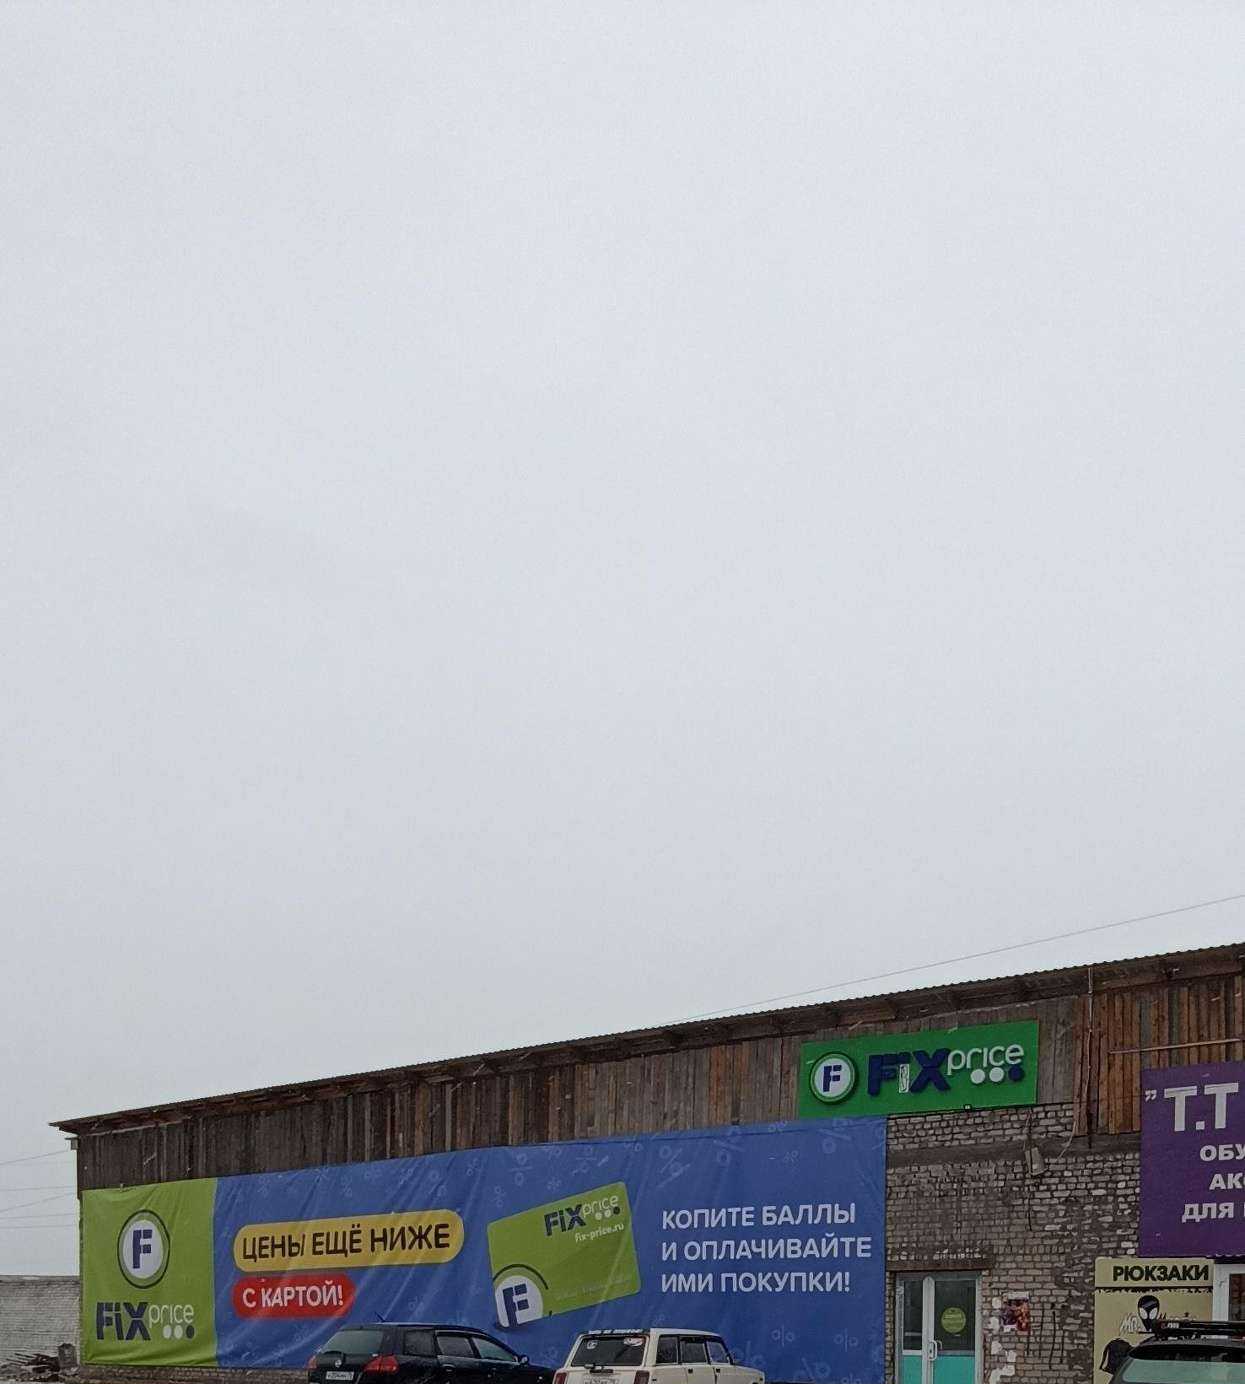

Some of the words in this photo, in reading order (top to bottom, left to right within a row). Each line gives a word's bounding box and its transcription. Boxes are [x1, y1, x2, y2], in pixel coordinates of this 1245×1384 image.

[947, 1044, 1025, 1076] price
[1209, 1172, 1245, 1190] АК
[661, 1206, 755, 1231] КОПИТЕ
[762, 1202, 856, 1227] БАЛЛЫ
[1181, 1202, 1234, 1223] ДЛЯ
[242, 1233, 305, 1263] ЦЕНЫ
[312, 1223, 362, 1258] ЕЩЁ
[369, 1222, 451, 1253] НИЖЕ
[661, 1241, 678, 1262] И
[683, 1231, 873, 1262] ОПЛАЧИВАЙТЕ
[661, 1272, 714, 1293] ИМИ
[720, 1270, 850, 1293] ПОКУПКИ!
[1112, 1264, 1210, 1283] РЮКЗАКИ
[242, 1287, 257, 1309] С
[260, 1279, 344, 1308] КАРТОЙ!
[148, 1302, 195, 1325] price
